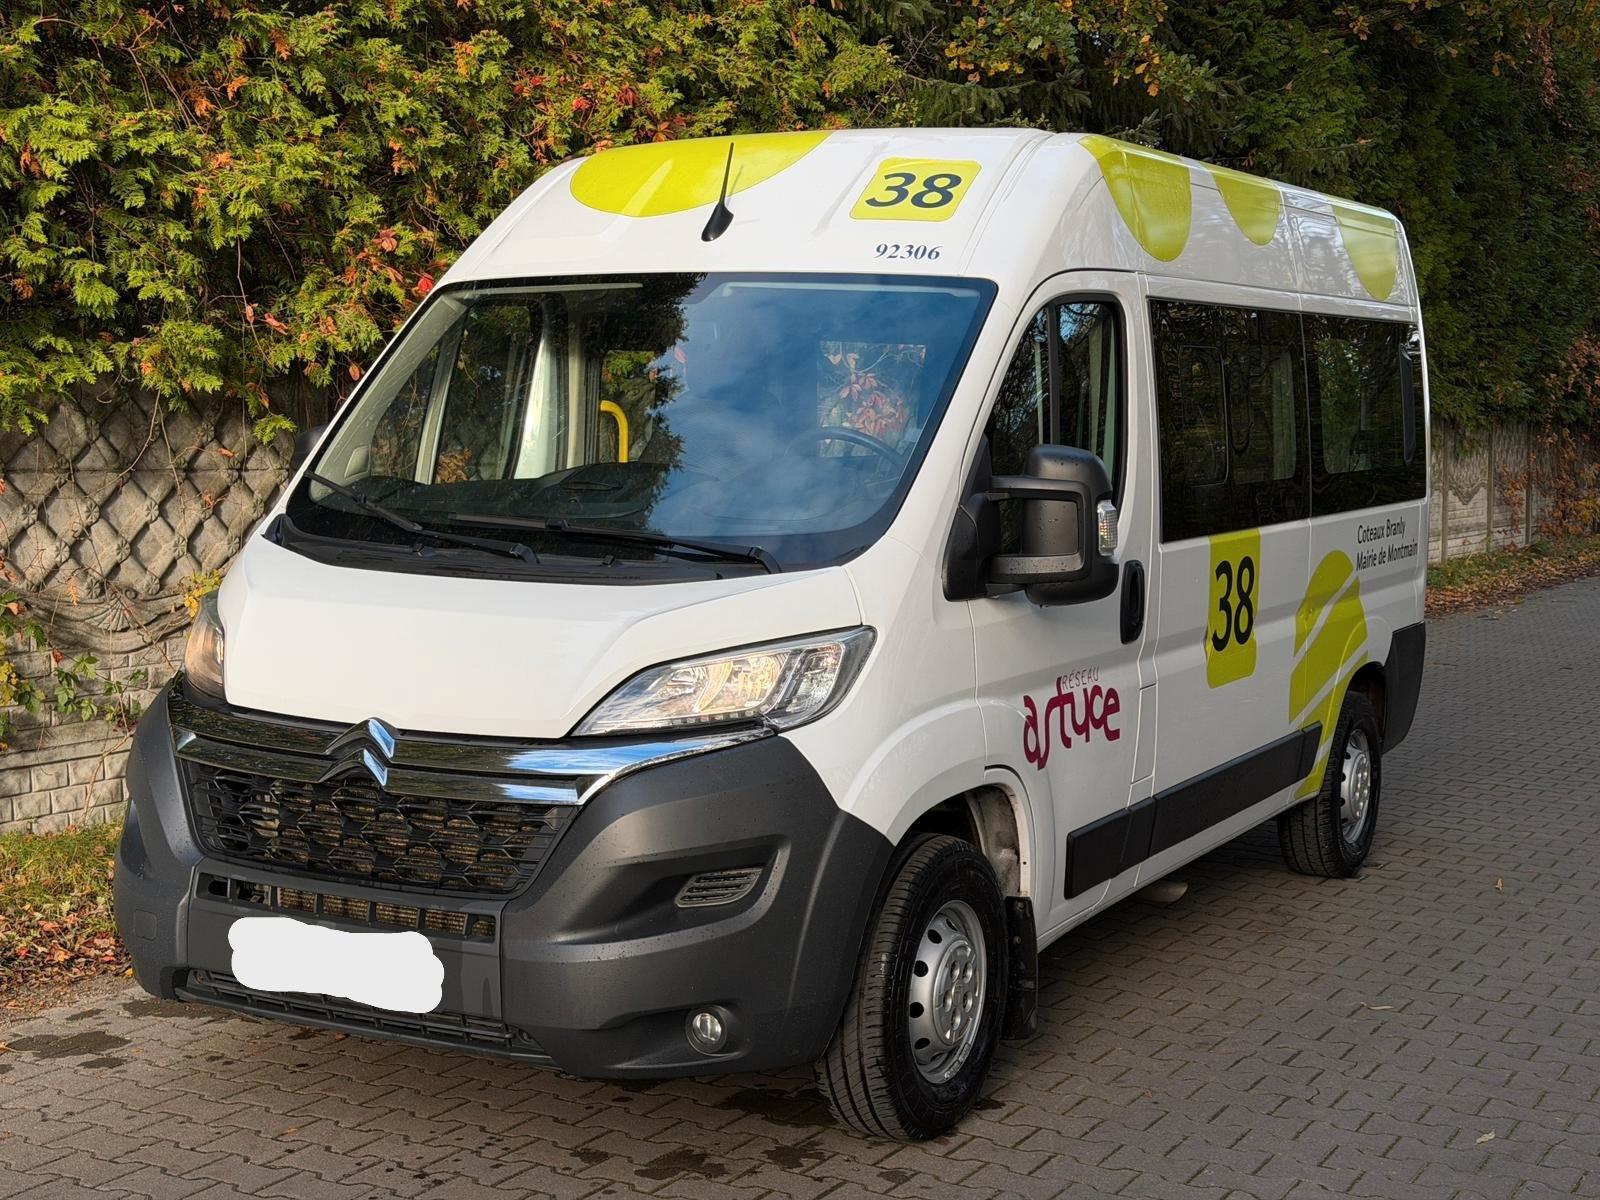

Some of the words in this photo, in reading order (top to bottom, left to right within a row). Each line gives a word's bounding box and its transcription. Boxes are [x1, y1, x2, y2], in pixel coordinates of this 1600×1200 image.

[865, 173, 962, 208] 38
[874, 243, 943, 260] 92306
[1358, 525, 1385, 544] Coteaux
[1386, 516, 1406, 538] Branly
[1356, 549, 1377, 571] Mairie
[1378, 546, 1387, 565] de
[1387, 538, 1417, 563] Montmain
[1212, 556, 1255, 651] 38
